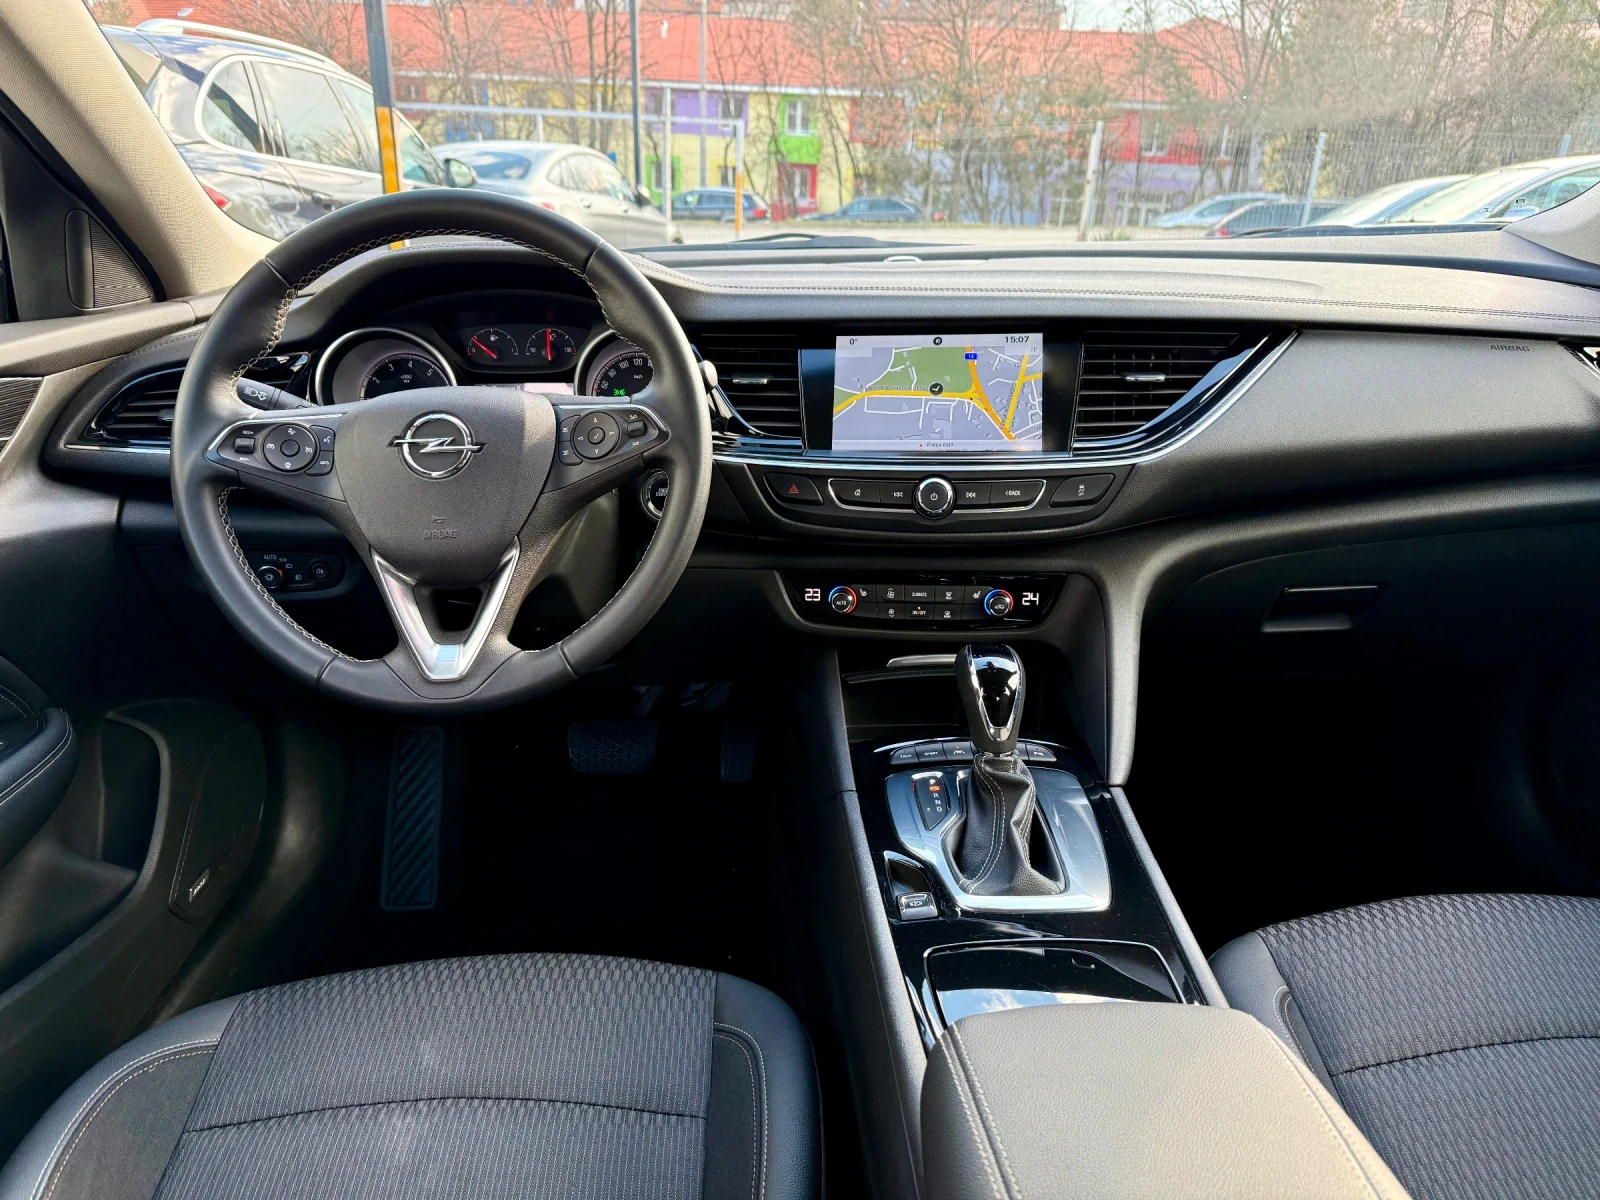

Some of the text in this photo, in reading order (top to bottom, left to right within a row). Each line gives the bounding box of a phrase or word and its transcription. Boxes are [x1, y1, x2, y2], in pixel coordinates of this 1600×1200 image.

[1490, 344, 1530, 352] AIRBAG
[388, 363, 394, 371] 3
[618, 360, 629, 369] 100
[426, 368, 434, 376] 5
[608, 369, 616, 378] 80
[600, 381, 608, 389] 60
[805, 588, 821, 601] 23
[1022, 592, 1039, 605] 24
